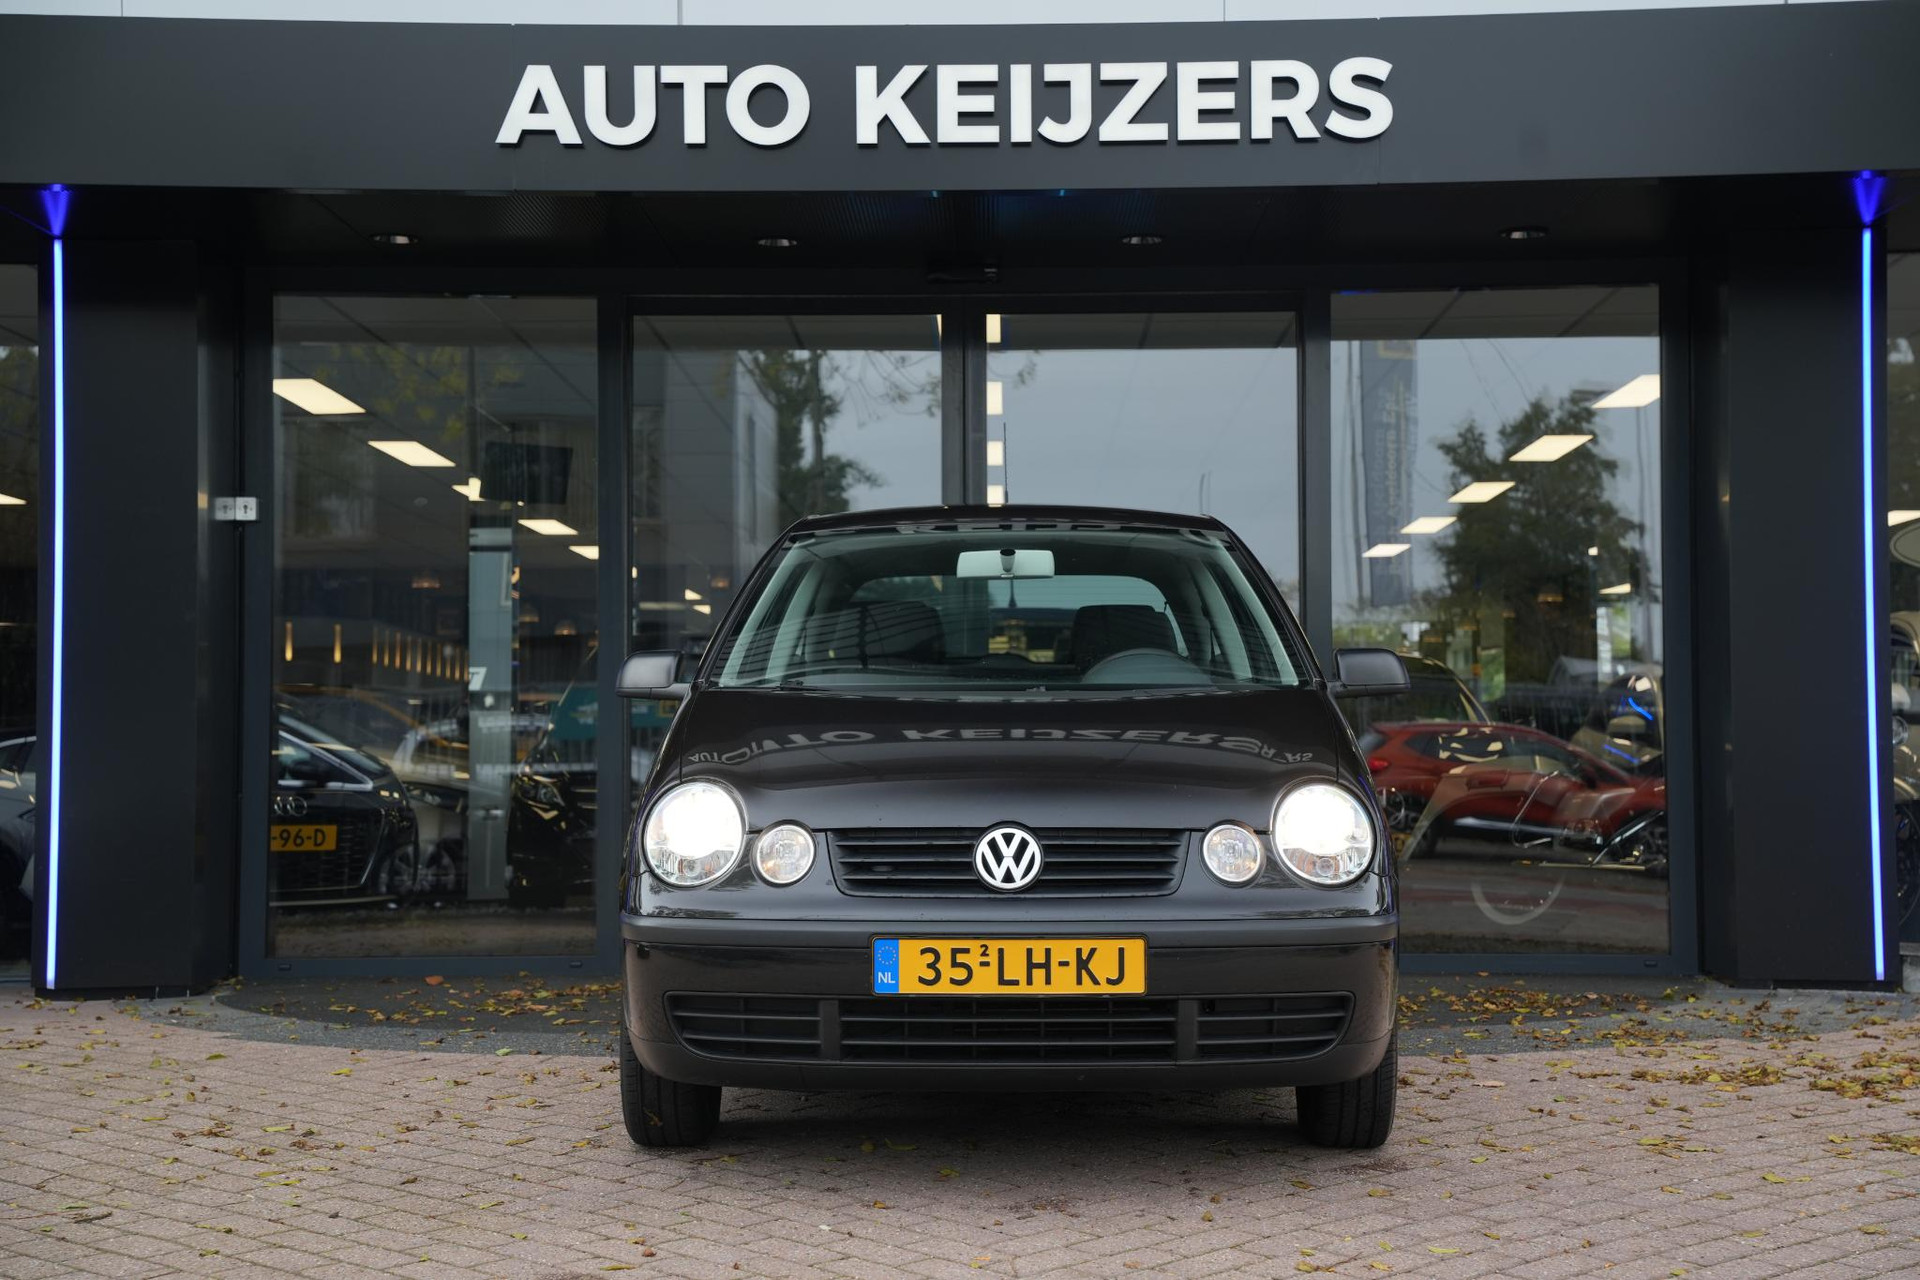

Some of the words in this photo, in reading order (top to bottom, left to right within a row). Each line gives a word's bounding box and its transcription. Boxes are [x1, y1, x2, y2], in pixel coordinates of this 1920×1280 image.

[495, 64, 810, 146] AUTO
[855, 57, 1394, 144] KEIJZERS
[877, 971, 896, 984] NL
